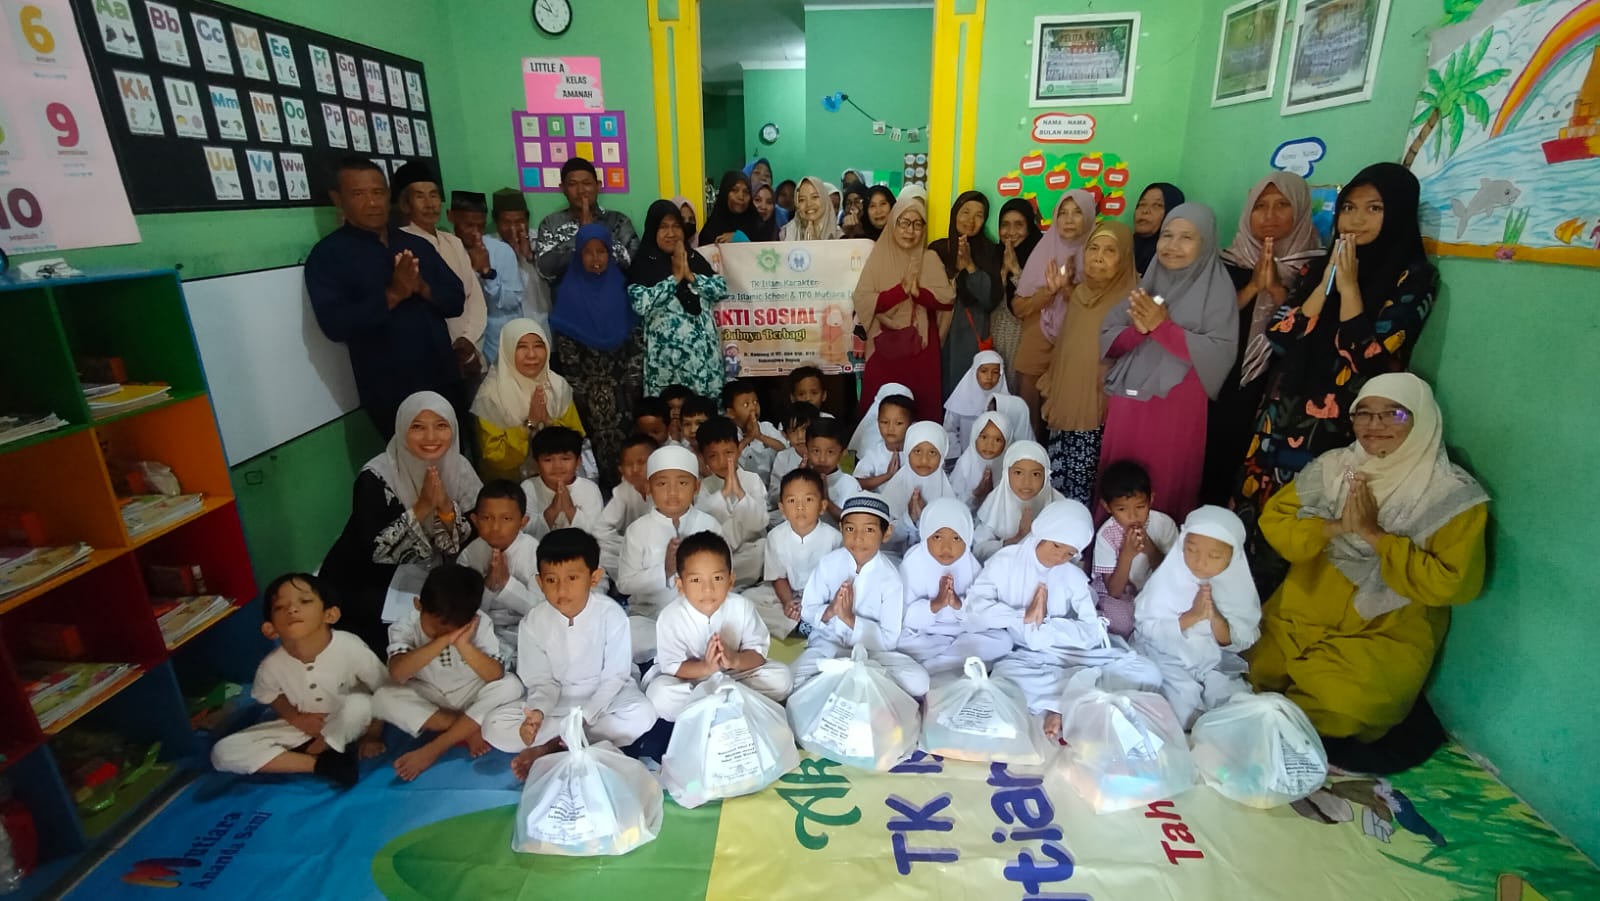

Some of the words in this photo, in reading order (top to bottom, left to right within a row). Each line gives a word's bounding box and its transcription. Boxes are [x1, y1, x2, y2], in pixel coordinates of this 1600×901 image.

[19, 5, 55, 54] 6
[149, 7, 180, 34] Bb
[196, 19, 223, 43] Cc
[234, 26, 261, 52] Dd
[270, 37, 291, 59] Ee
[313, 49, 328, 68] Ff
[339, 55, 356, 77] Gg
[530, 62, 556, 73] LITTLE
[559, 63, 565, 73] A
[364, 62, 381, 82] Hh
[565, 76, 587, 85] KELAS
[120, 77, 152, 101] Kk
[562, 90, 593, 98] AMANAH
[211, 91, 241, 110] Mm
[253, 96, 277, 116] Nn
[284, 101, 305, 120] Oo
[46, 102, 79, 147] 9
[324, 105, 341, 125] Pp
[349, 110, 366, 129] Qq
[375, 115, 388, 132] Rr
[396, 119, 410, 135] Ss
[207, 151, 235, 172] Uu
[249, 154, 273, 173] Vv
[281, 158, 304, 172] Ww
[737, 291, 762, 301] Islamic
[765, 291, 788, 300] School
[754, 307, 817, 326] SOSIAL
[722, 328, 761, 342] dahnya
[761, 328, 807, 342] Berbagi
[885, 795, 960, 875] TK
[986, 762, 1080, 901] tiar
[1144, 800, 1205, 866] Tah
[189, 840, 245, 890] Ananda
[233, 810, 273, 840] Sami
